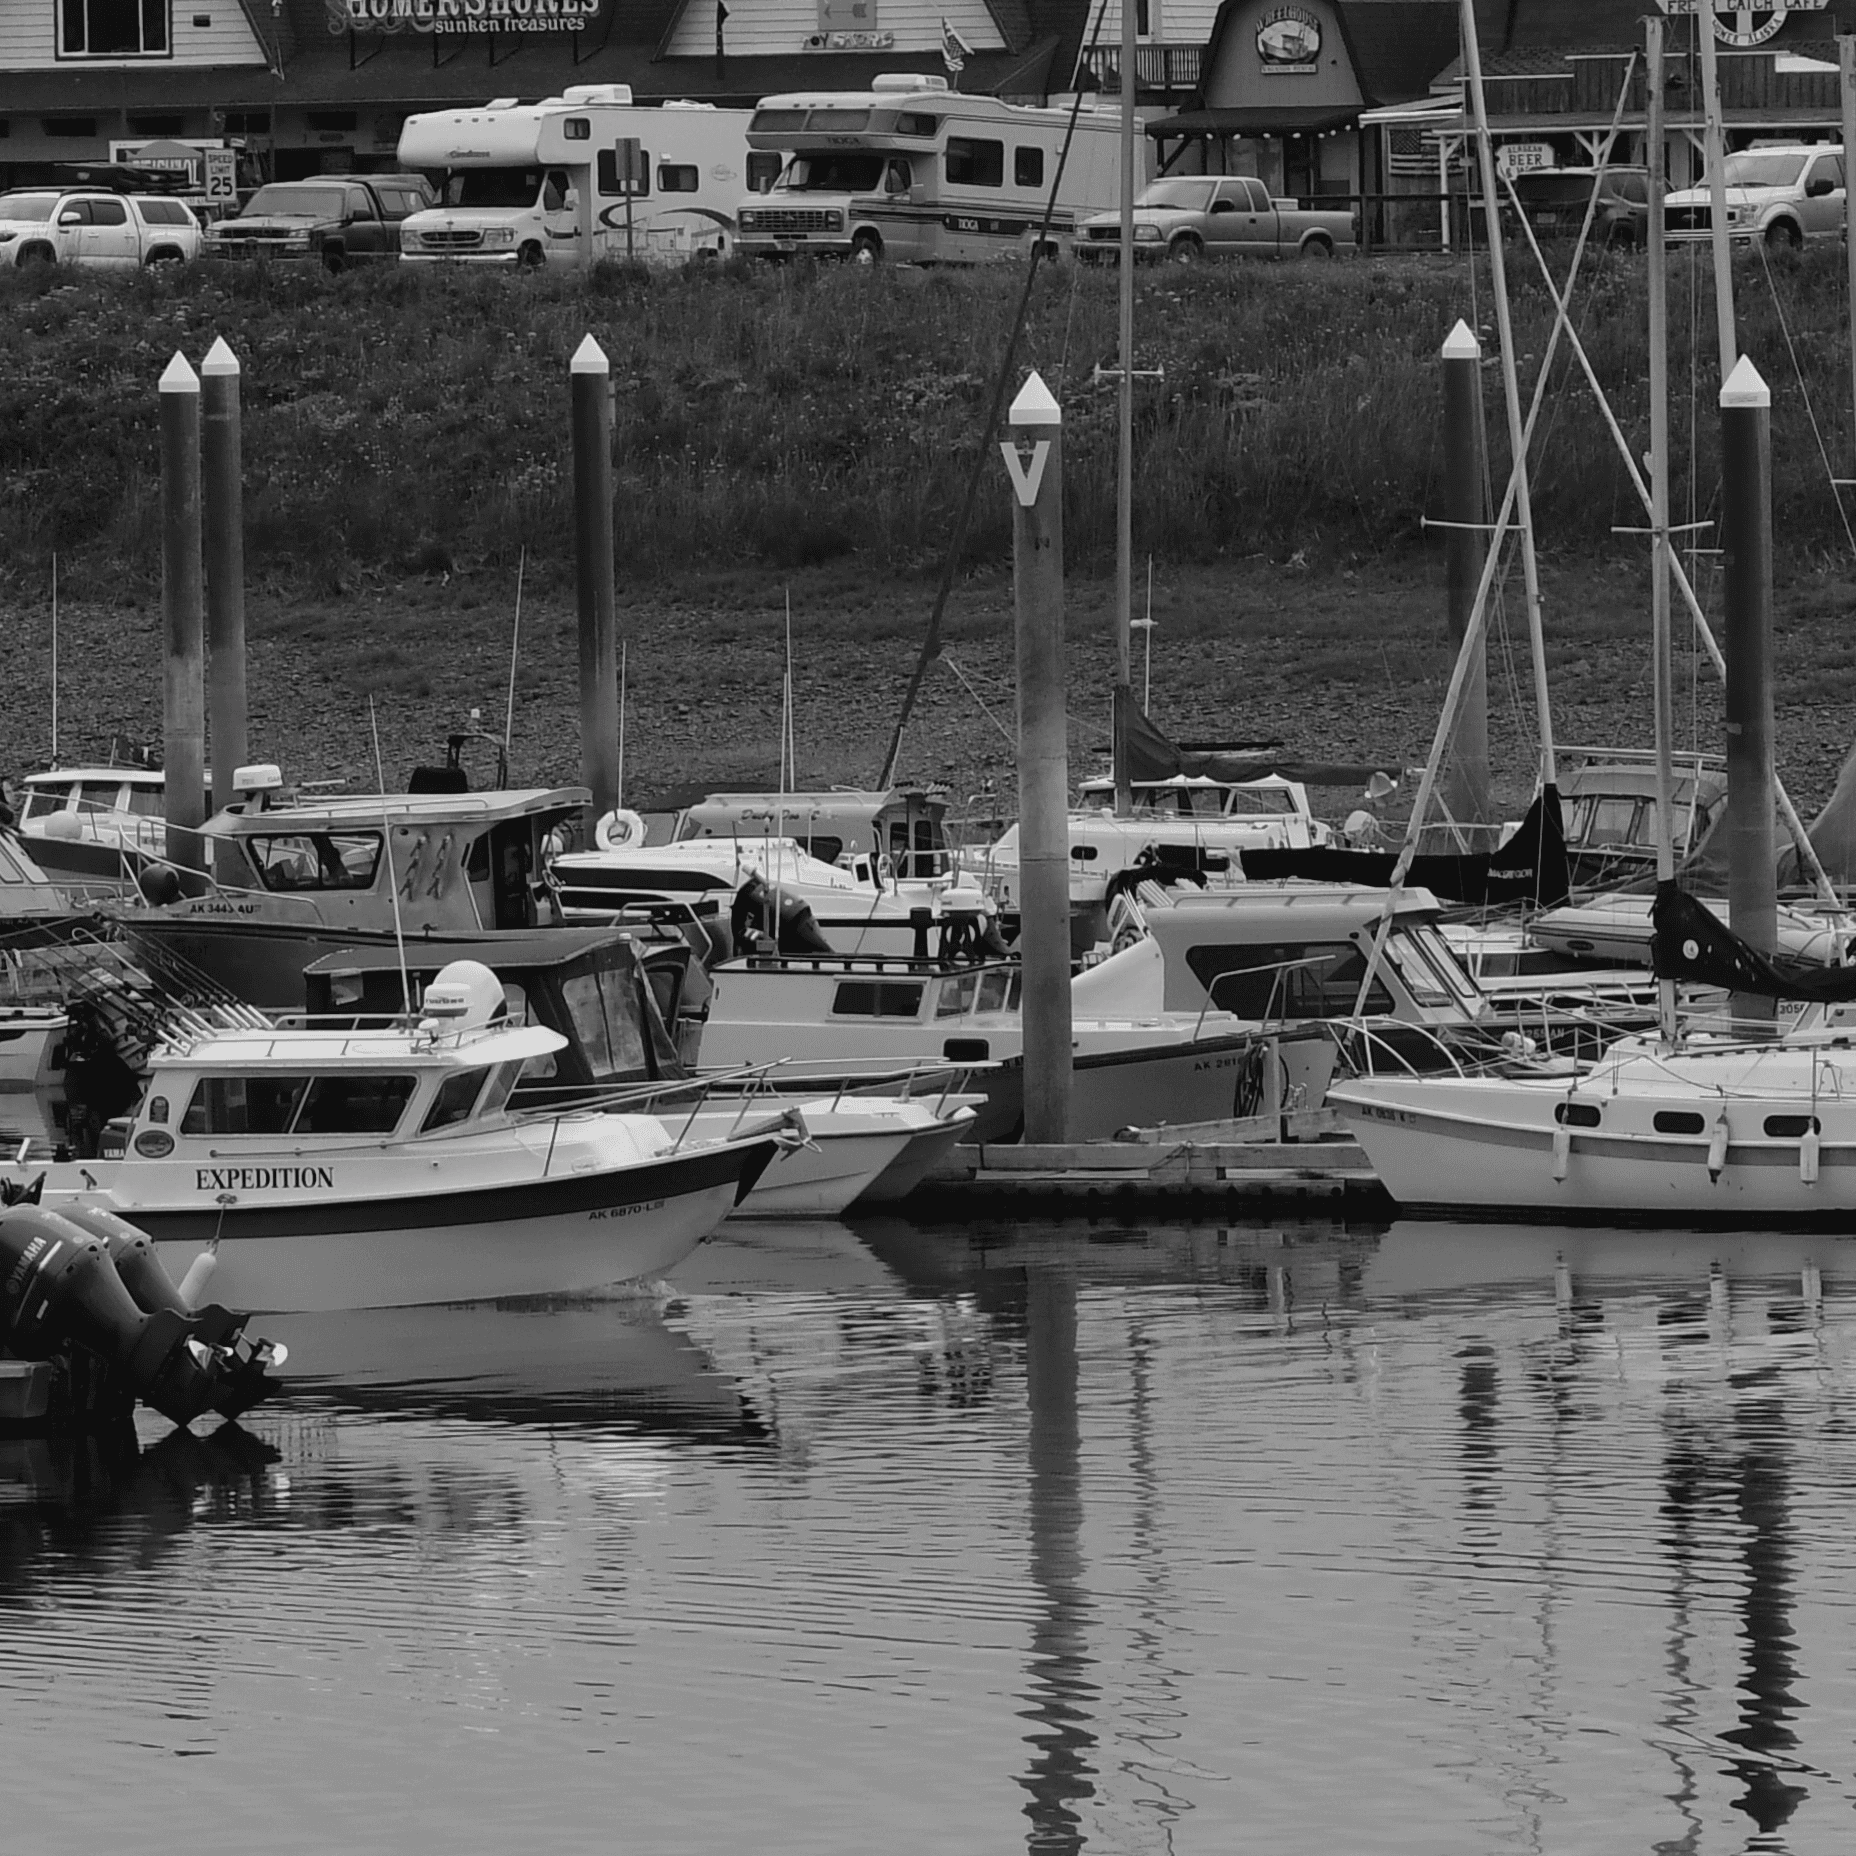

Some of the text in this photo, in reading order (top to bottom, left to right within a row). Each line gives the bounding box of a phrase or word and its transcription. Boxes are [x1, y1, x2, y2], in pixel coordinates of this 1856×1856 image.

[435, 16, 586, 33] sunken treasures
[1747, 18, 1782, 44] ALASKA
[208, 153, 234, 164] SPEED
[1508, 153, 1543, 167] BEER
[210, 164, 231, 175] LIMIT
[210, 176, 233, 197] 25
[190, 903, 205, 914] AK
[103, 1148, 125, 1159] YAMA
[196, 1166, 335, 1190] EXPEDITION
[589, 1210, 607, 1220] AK
[12, 1236, 48, 1282] YAMAHA
